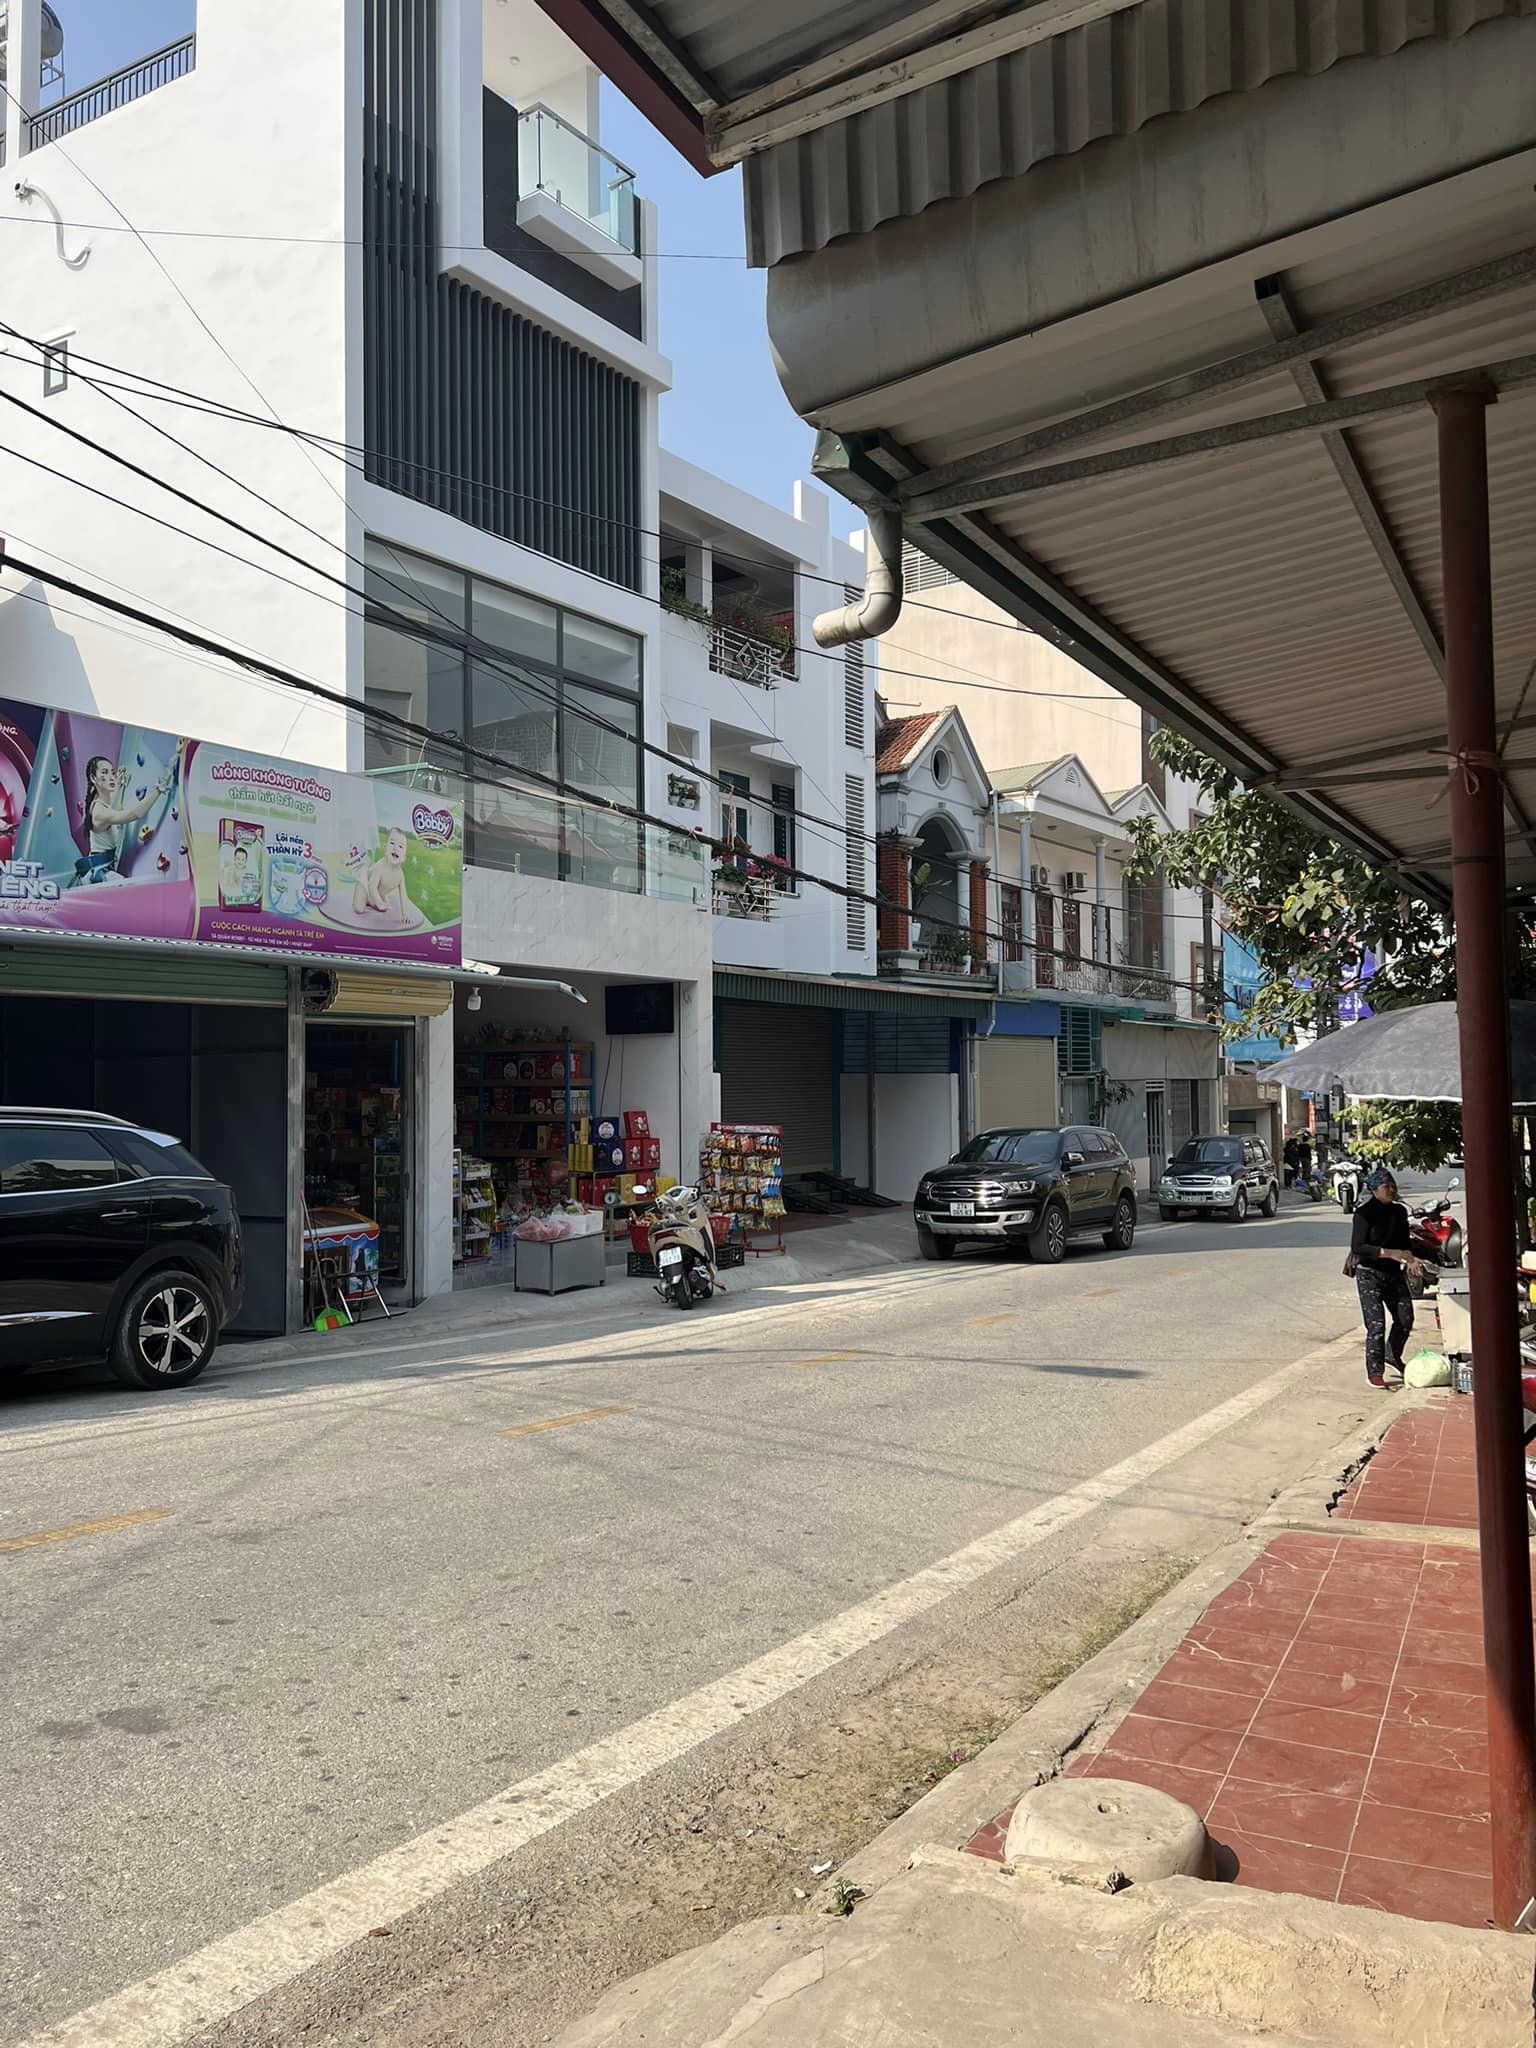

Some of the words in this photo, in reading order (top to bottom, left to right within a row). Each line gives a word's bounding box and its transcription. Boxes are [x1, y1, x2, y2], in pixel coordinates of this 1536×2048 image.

[212, 762, 250, 781] MỎNG
[251, 769, 292, 790] KHÔNG
[292, 778, 331, 801] TƯỞNG
[416, 811, 450, 835] Bobby
[303, 842, 313, 858] 3
[0, 874, 60, 899] ÊNG
[211, 920, 232, 930] CUỘC
